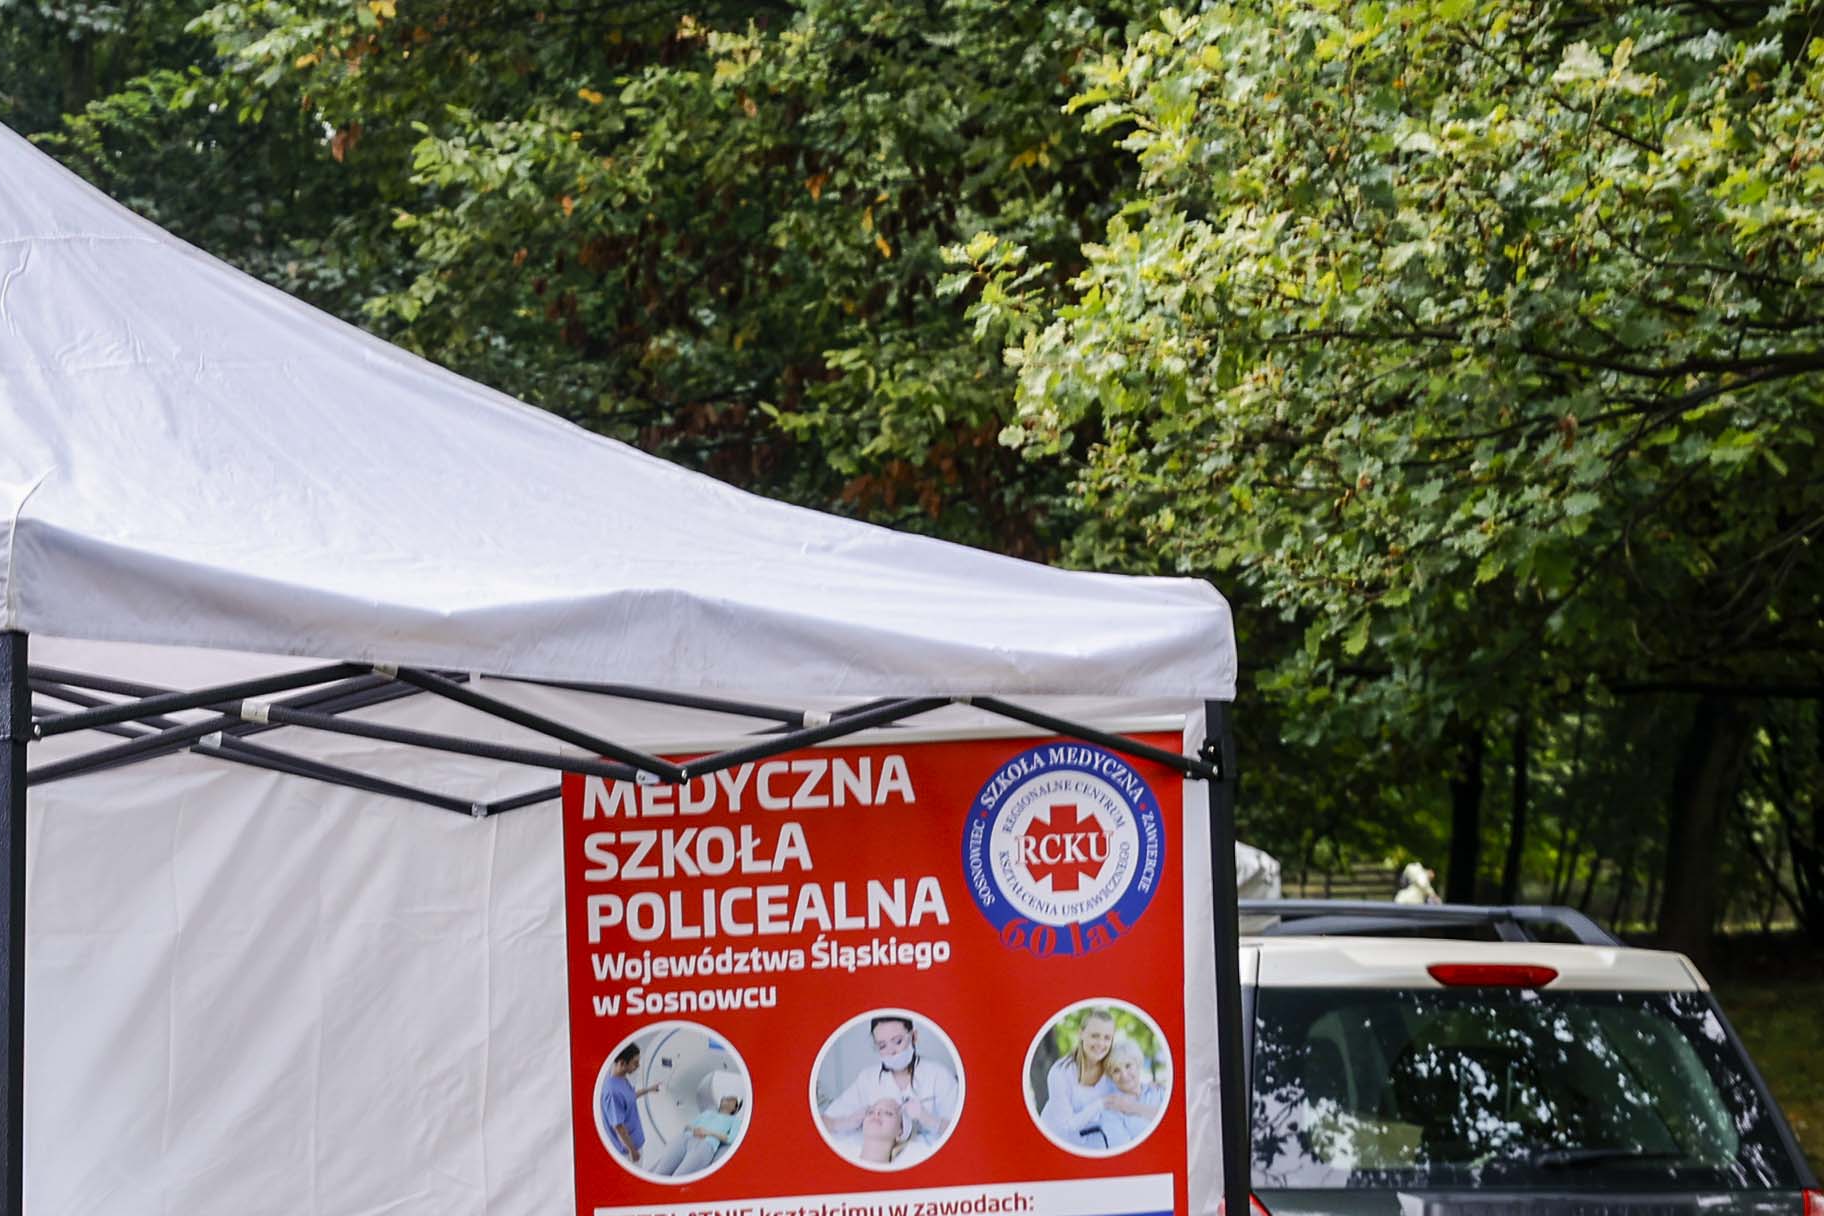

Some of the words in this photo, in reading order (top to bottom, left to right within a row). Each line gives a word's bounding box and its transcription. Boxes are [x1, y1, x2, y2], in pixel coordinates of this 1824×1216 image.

[583, 755, 915, 820] MEDYCZNA
[980, 754, 1046, 810] SZKOŁA
[1049, 746, 1145, 803] MEDYCZNA
[1003, 780, 1072, 834] REGIONALNE
[1074, 780, 1126, 829] CENTRUM
[584, 822, 813, 881] SZKOŁA
[969, 818, 996, 908] SOSNOWIEC
[1014, 830, 1114, 866] RCKU
[1137, 810, 1159, 894] ZAWIERCIE
[587, 876, 950, 943] POLICEALNA
[1000, 917, 1057, 959] 60
[1064, 909, 1132, 958] lat
[592, 947, 806, 985] Województwa
[811, 934, 951, 973] Śląskiego
[593, 995, 620, 1017] w
[626, 985, 777, 1015] Sosnowcu
